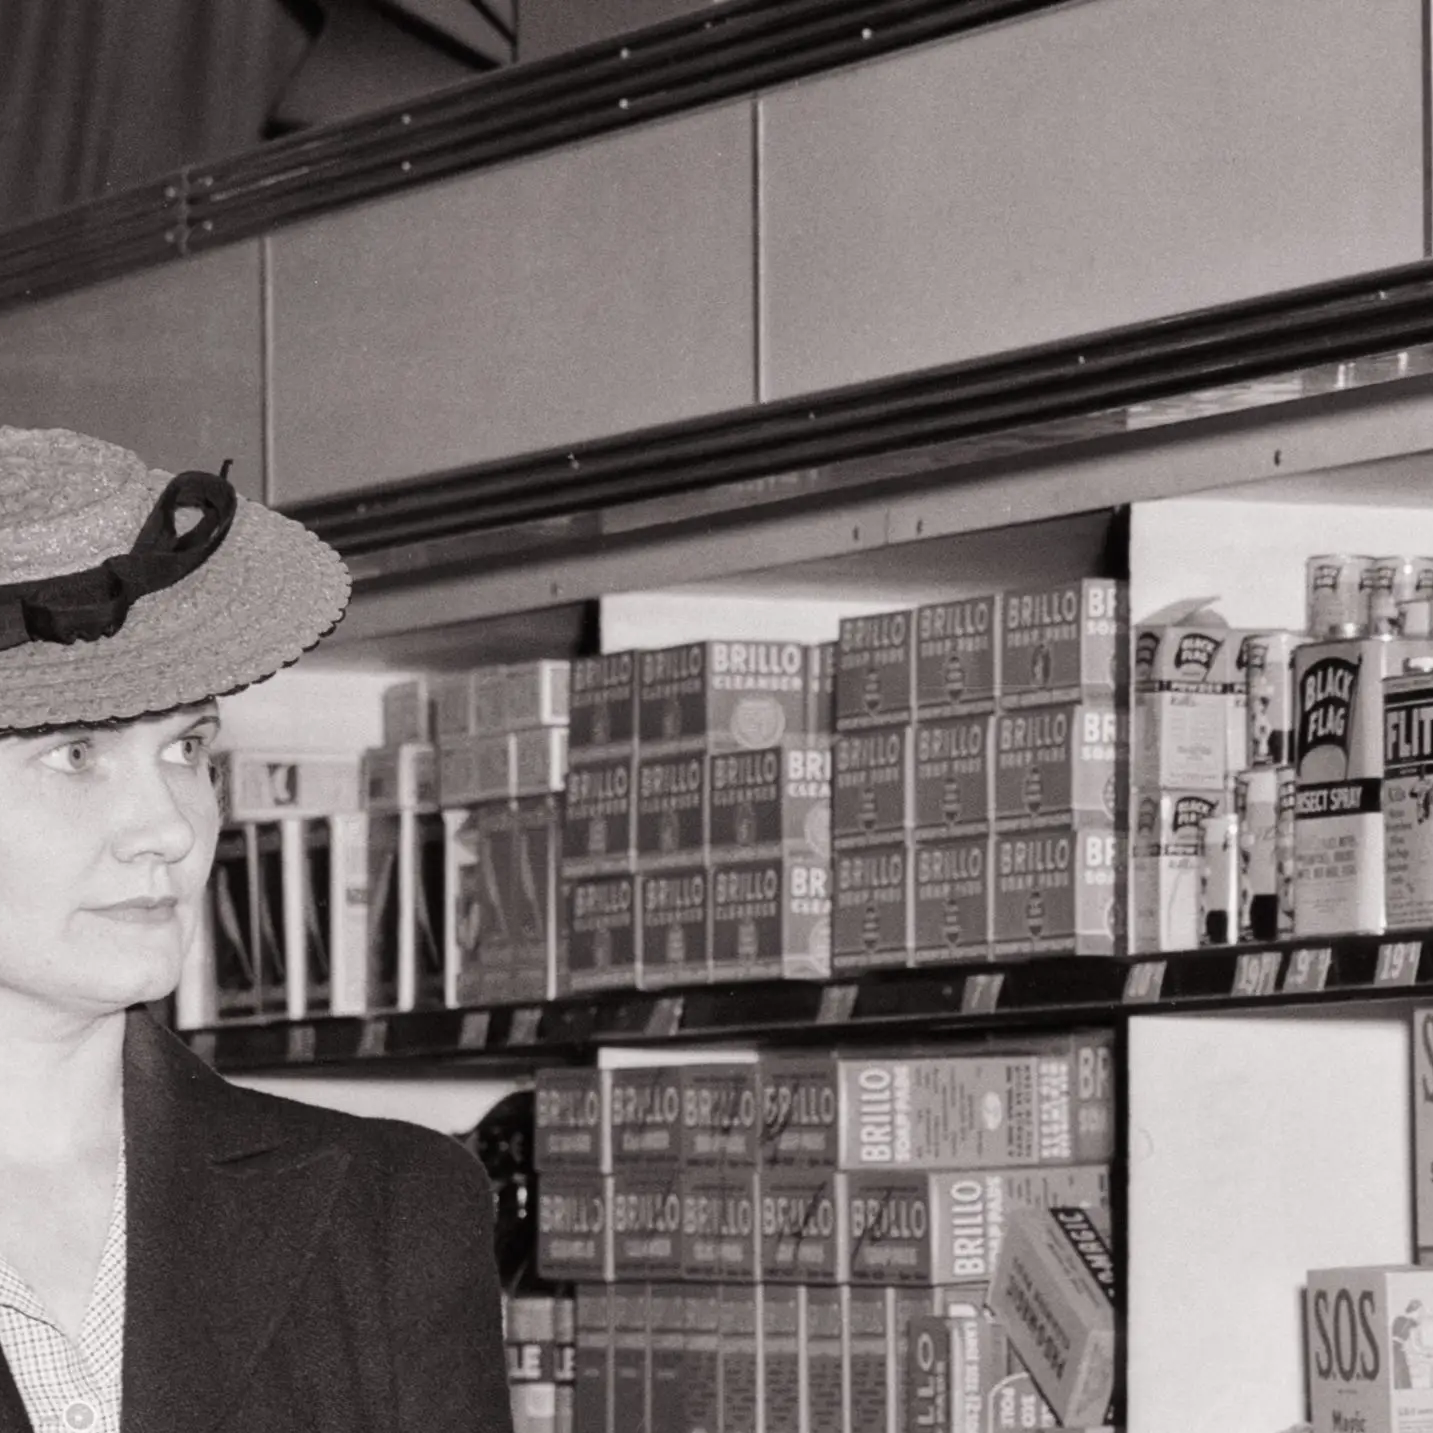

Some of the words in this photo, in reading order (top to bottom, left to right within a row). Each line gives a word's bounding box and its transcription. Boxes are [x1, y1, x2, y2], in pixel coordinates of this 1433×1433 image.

[1005, 591, 1078, 628] BRILLO
[711, 643, 801, 675] BRILLO
[1303, 664, 1353, 706] BLACK
[1308, 702, 1346, 742] FLAG
[1334, 785, 1369, 812] SPRAY
[860, 1066, 893, 1164] BRILLO
